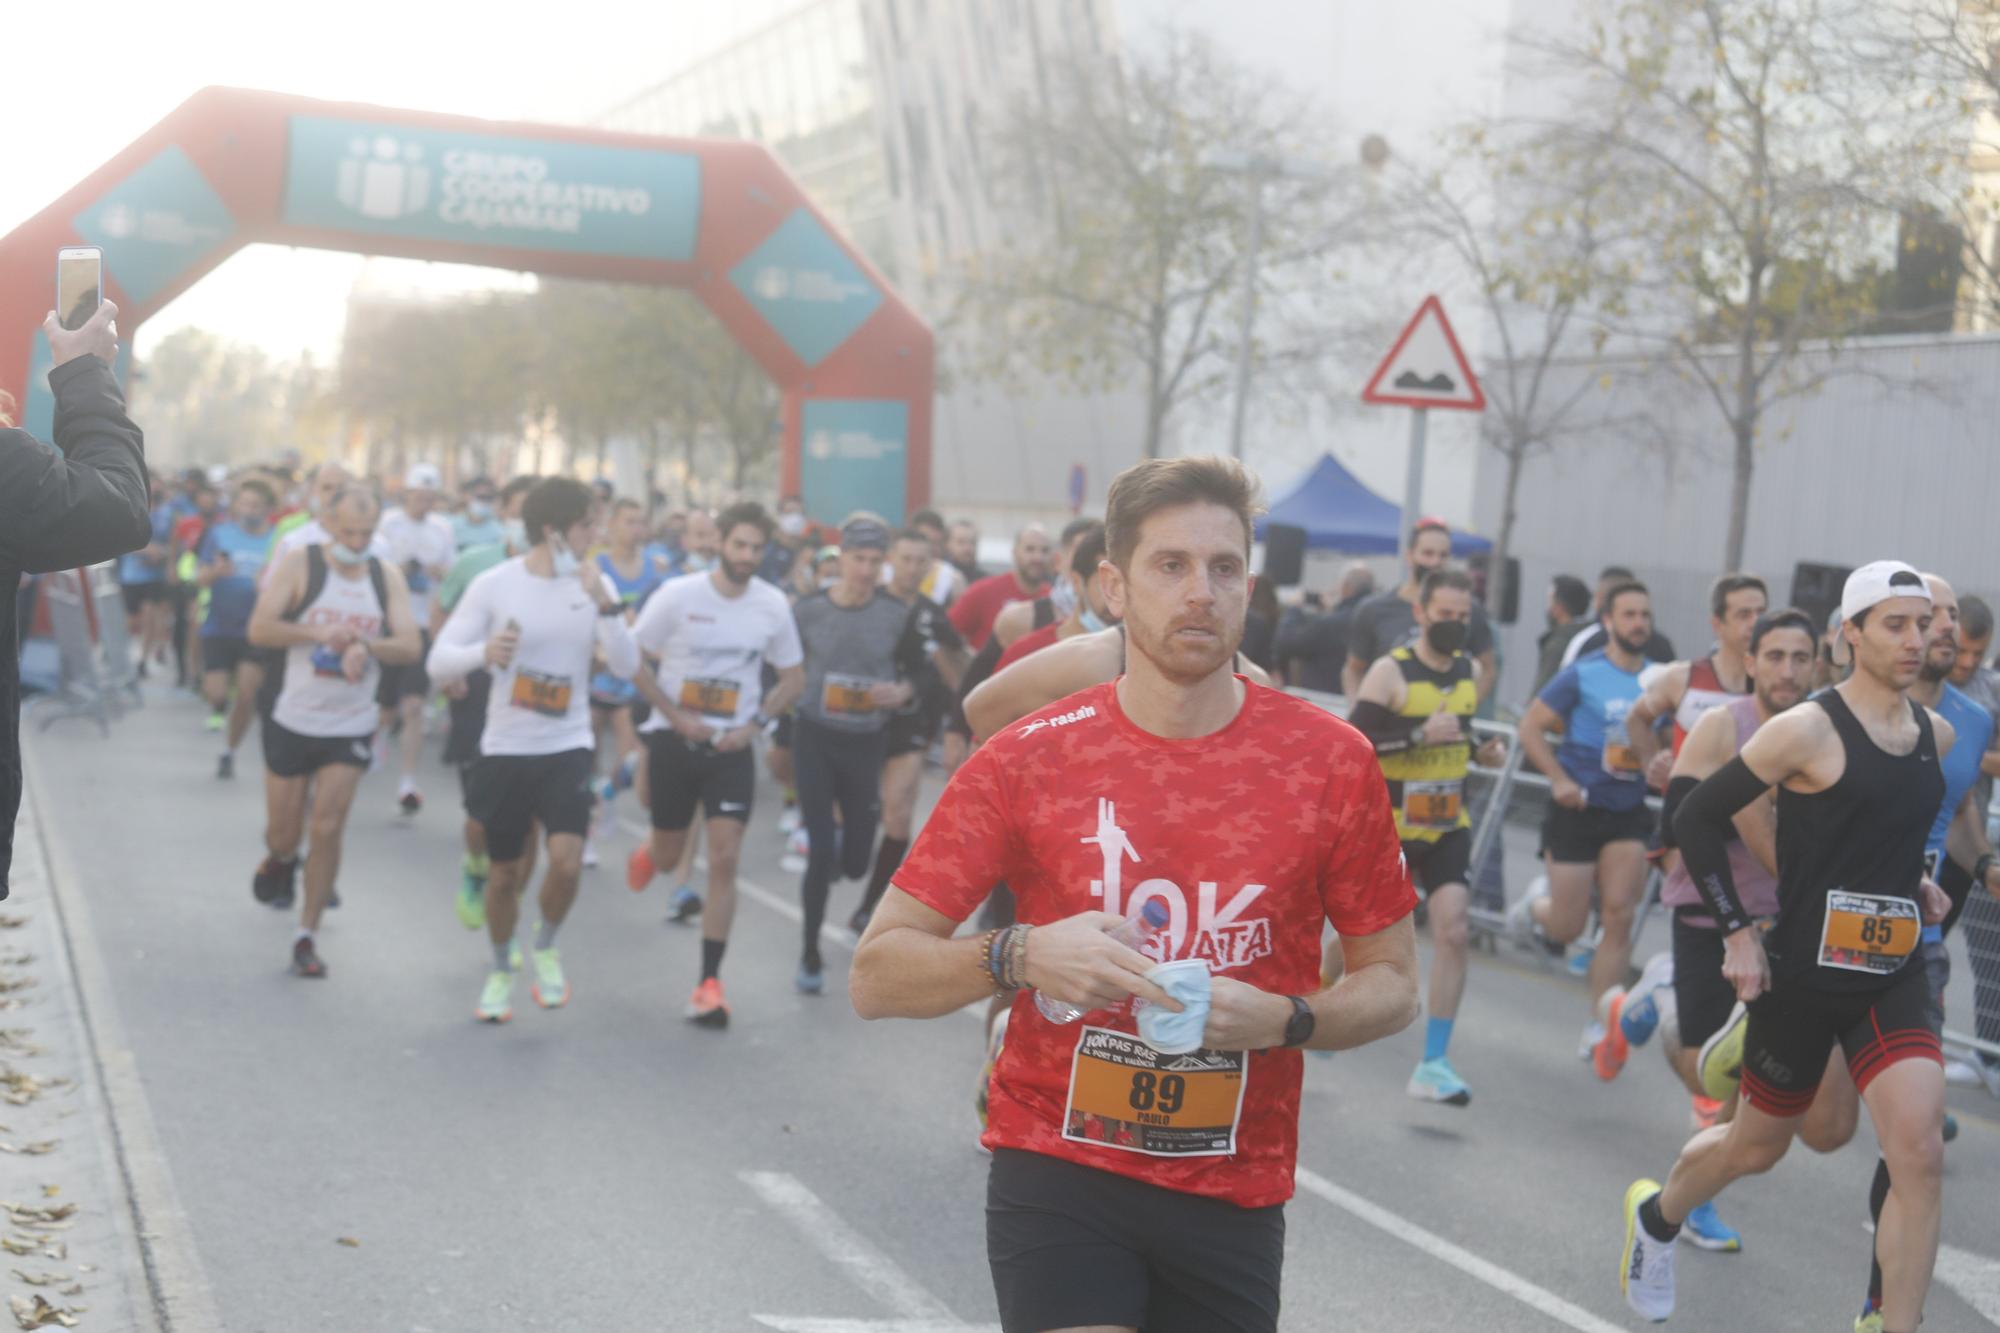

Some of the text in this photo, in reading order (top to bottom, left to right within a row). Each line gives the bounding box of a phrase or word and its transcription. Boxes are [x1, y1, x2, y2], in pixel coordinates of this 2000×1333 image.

[442, 149, 549, 181] GRUPO
[441, 174, 651, 216] COOPERATIVO
[439, 200, 582, 233] CAJAMAR
[1860, 916, 1893, 945] 85
[1086, 1032, 1159, 1061] 10K PAS RAS
[1092, 1049, 1111, 1060] PORT
[1112, 1054, 1122, 1063] DE
[1129, 1071, 1185, 1114] 89
[1137, 1112, 1170, 1125] PAULO
